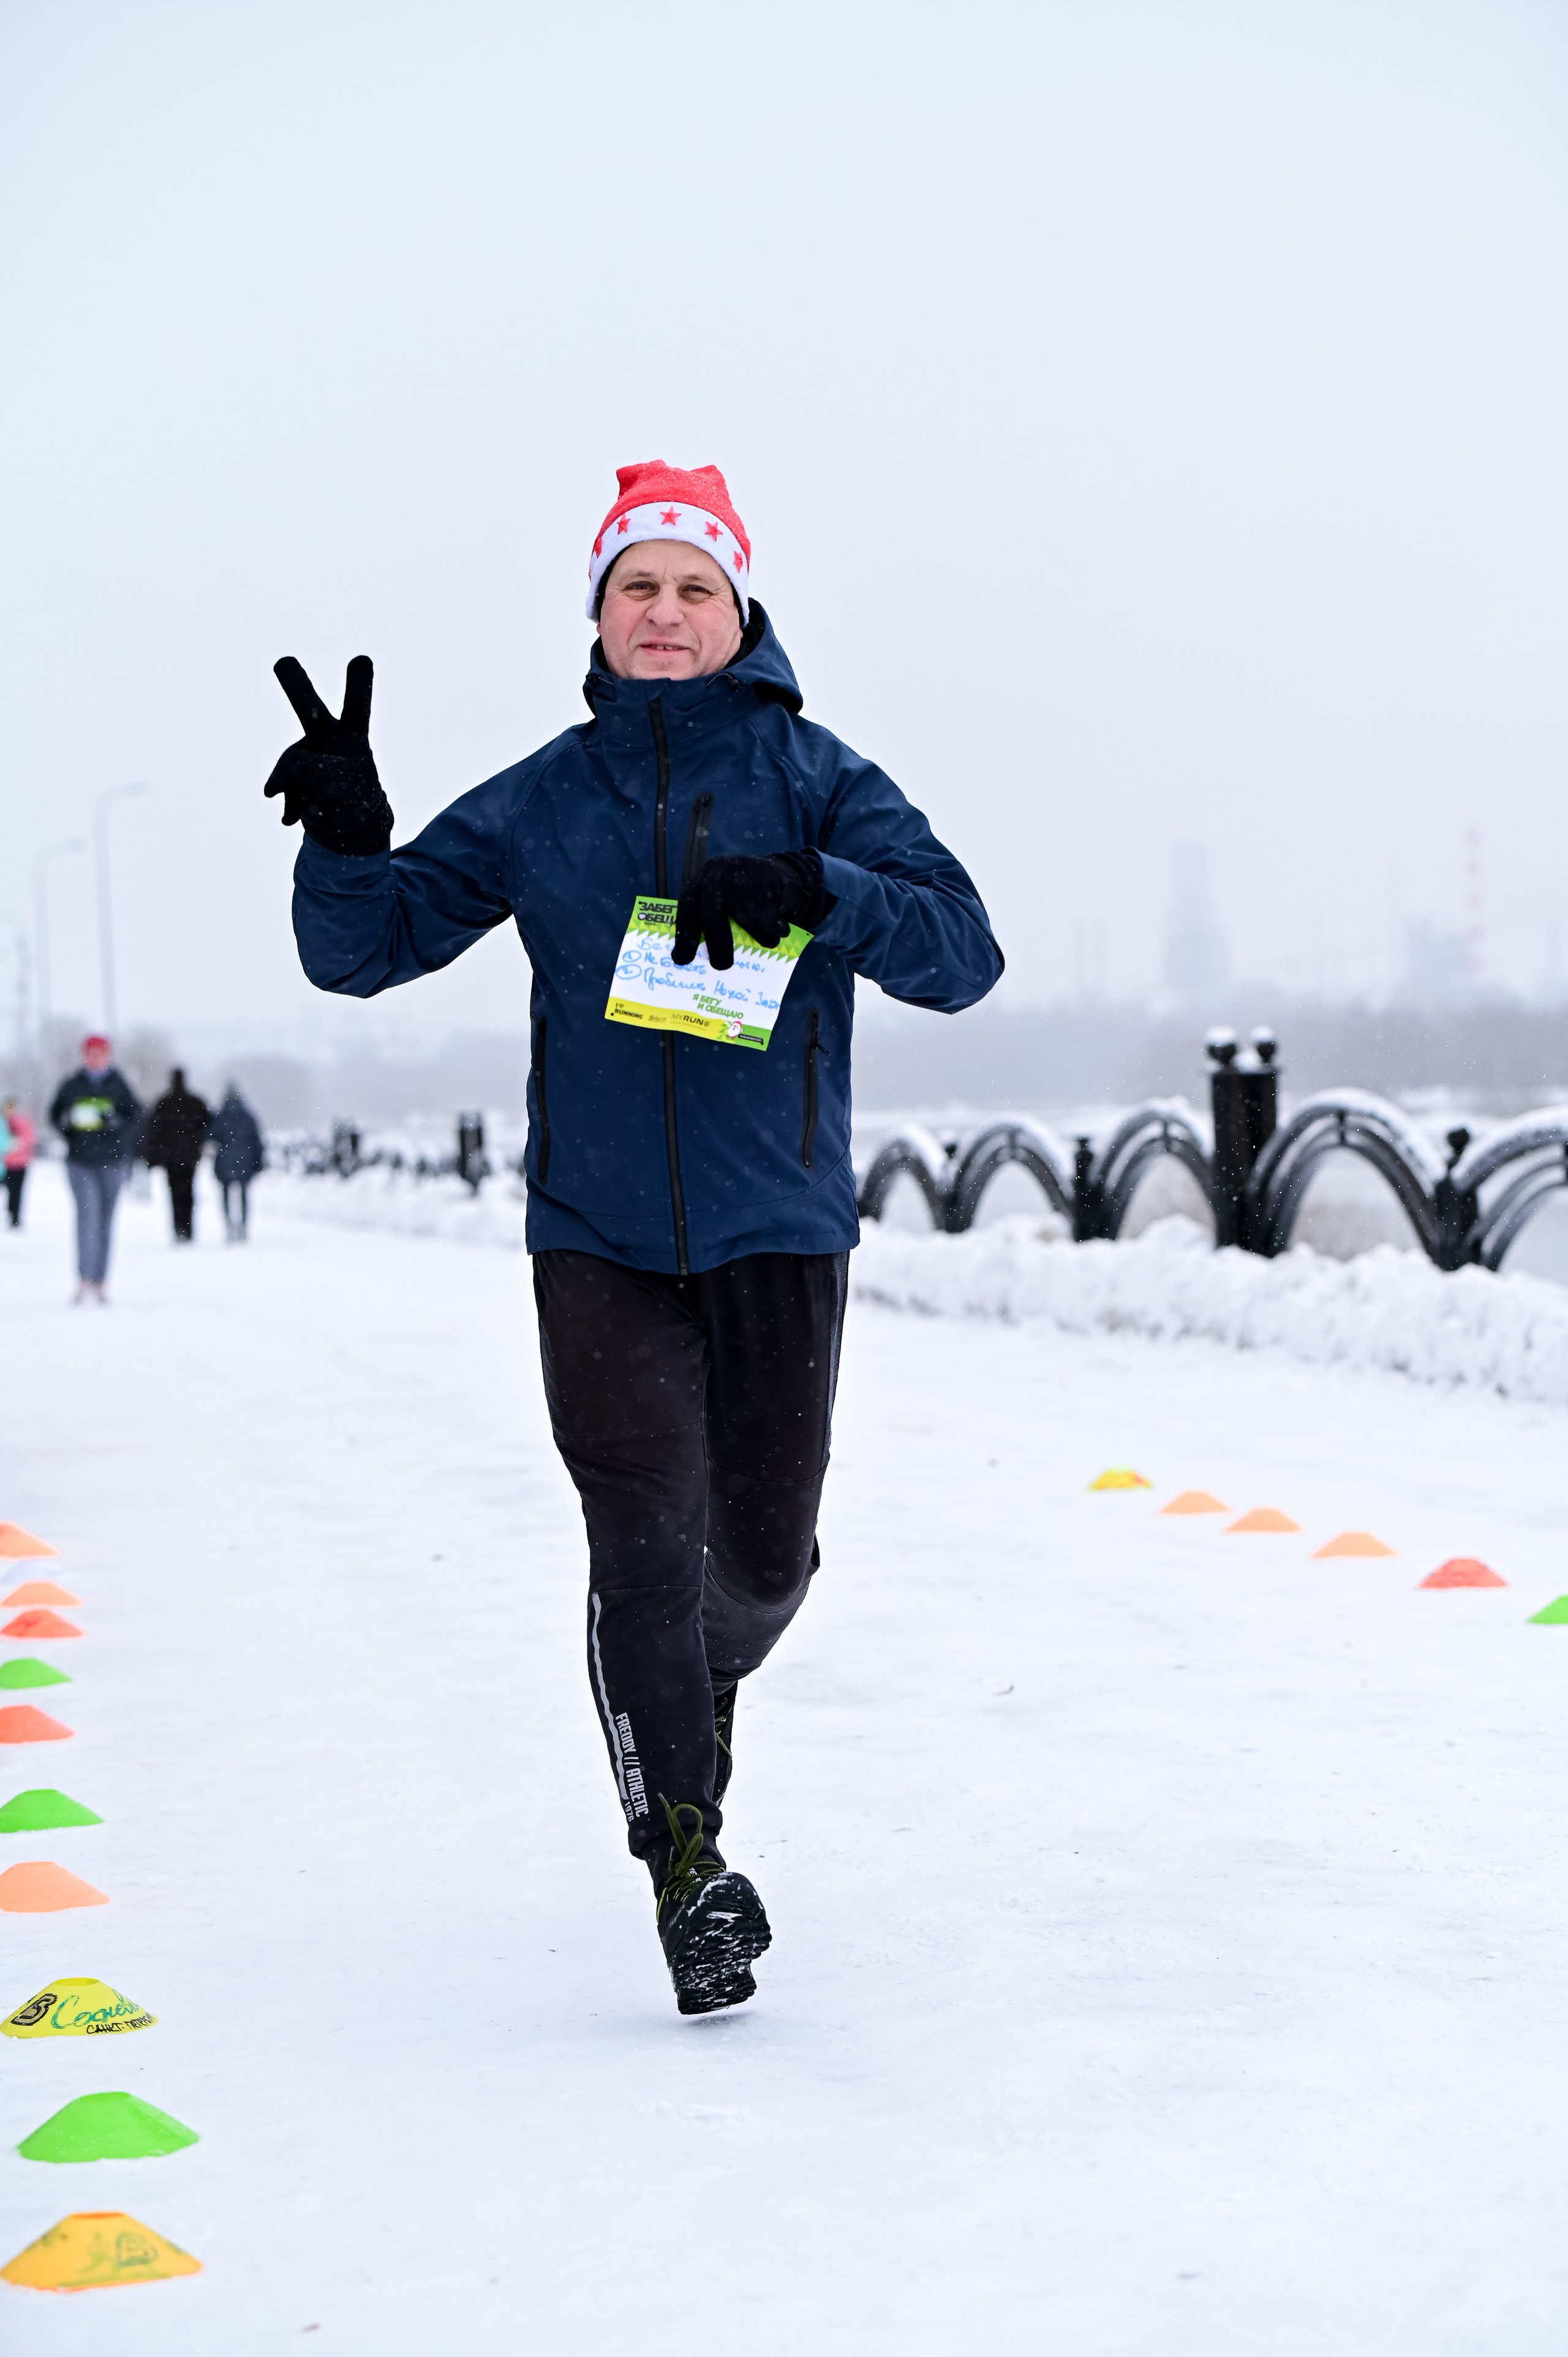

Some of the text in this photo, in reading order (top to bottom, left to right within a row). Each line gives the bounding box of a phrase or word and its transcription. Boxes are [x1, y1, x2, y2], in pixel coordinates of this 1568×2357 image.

[638, 912, 676, 927] ОБЕЩ
[700, 995, 722, 1006] БЕГУ
[614, 1009, 644, 1019] RUNNING
[705, 1005, 744, 1019] ОБЕЩАЮ
[615, 1712, 636, 1754] FREDDY
[625, 1767, 649, 1818] ATHLETIC
[624, 1801, 635, 1822] 1976
